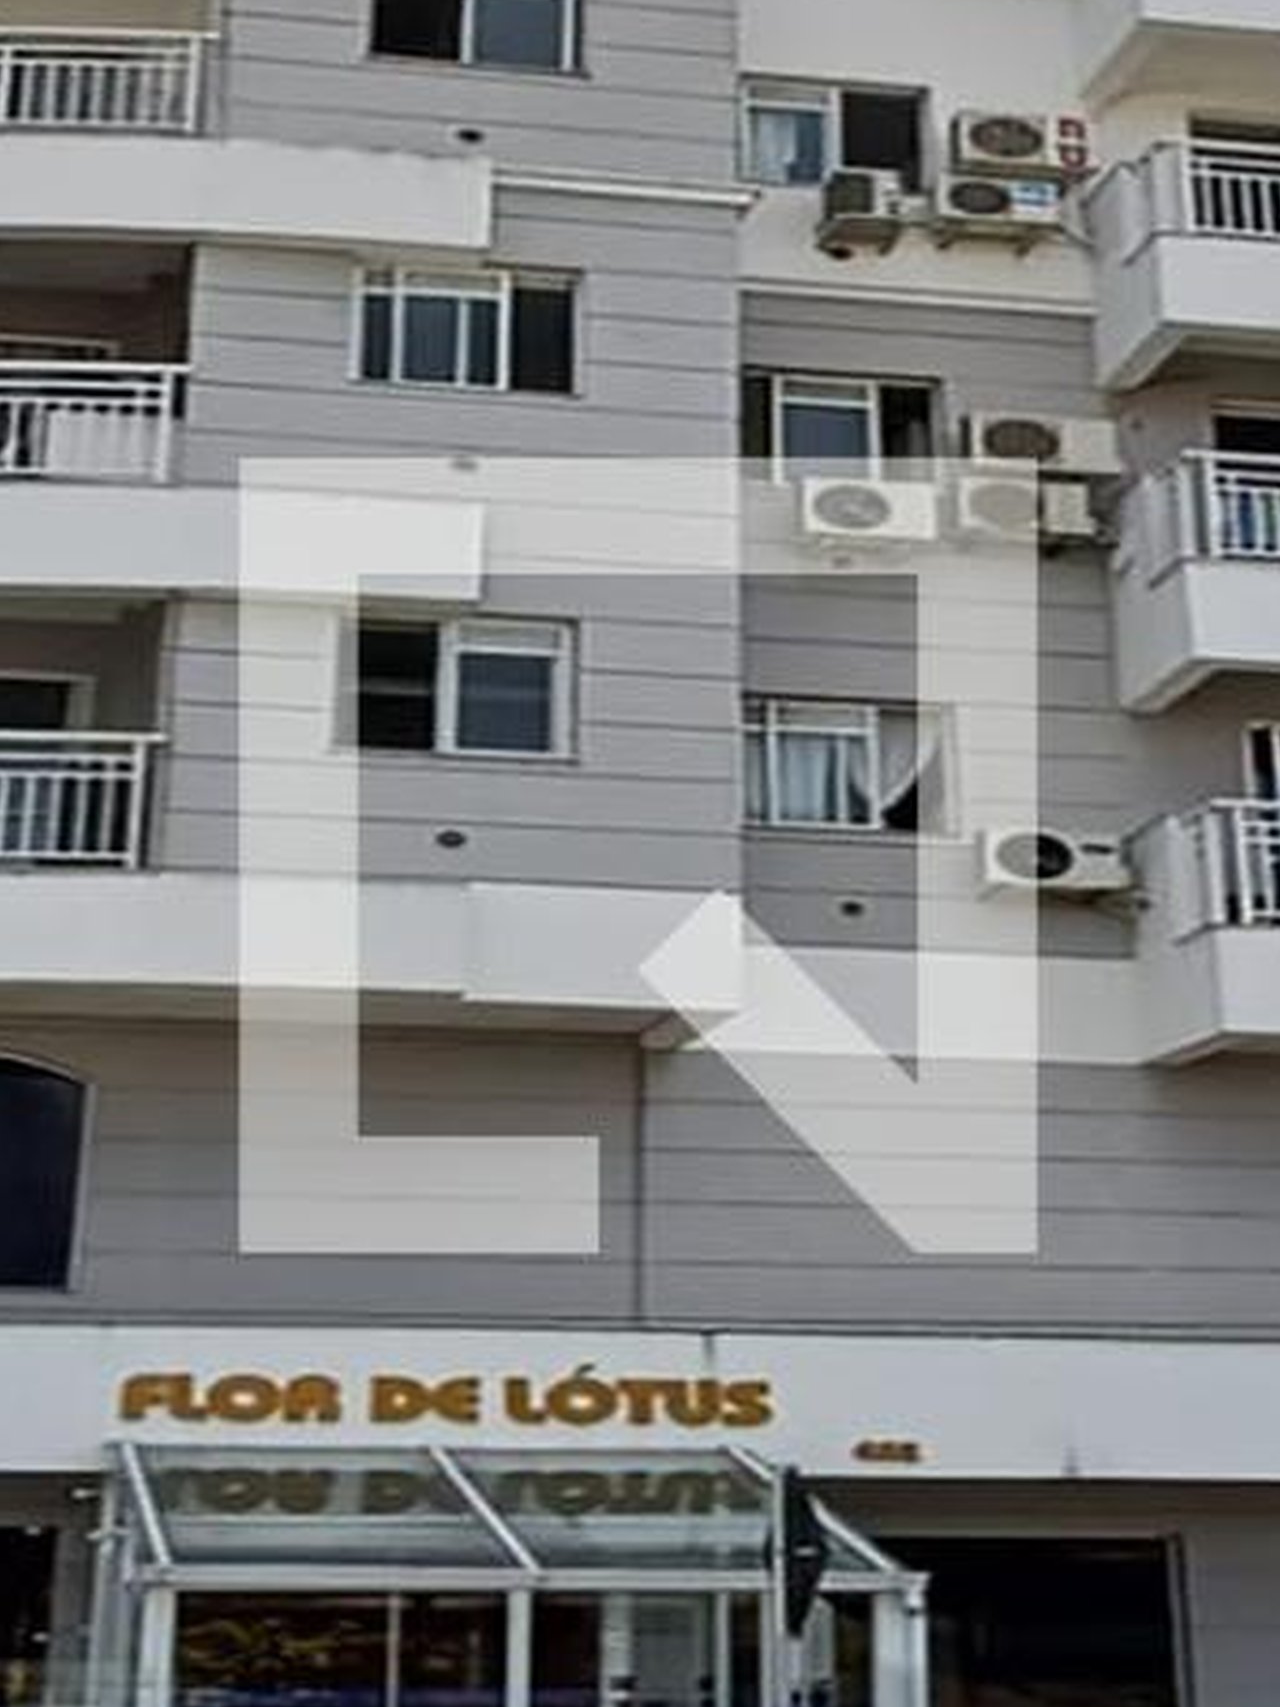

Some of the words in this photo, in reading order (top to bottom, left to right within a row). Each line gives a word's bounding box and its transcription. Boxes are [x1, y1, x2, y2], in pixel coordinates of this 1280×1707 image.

[119, 1372, 342, 1423] FLOR
[369, 1374, 480, 1424] DE
[503, 1364, 773, 1427] LÓTUS
